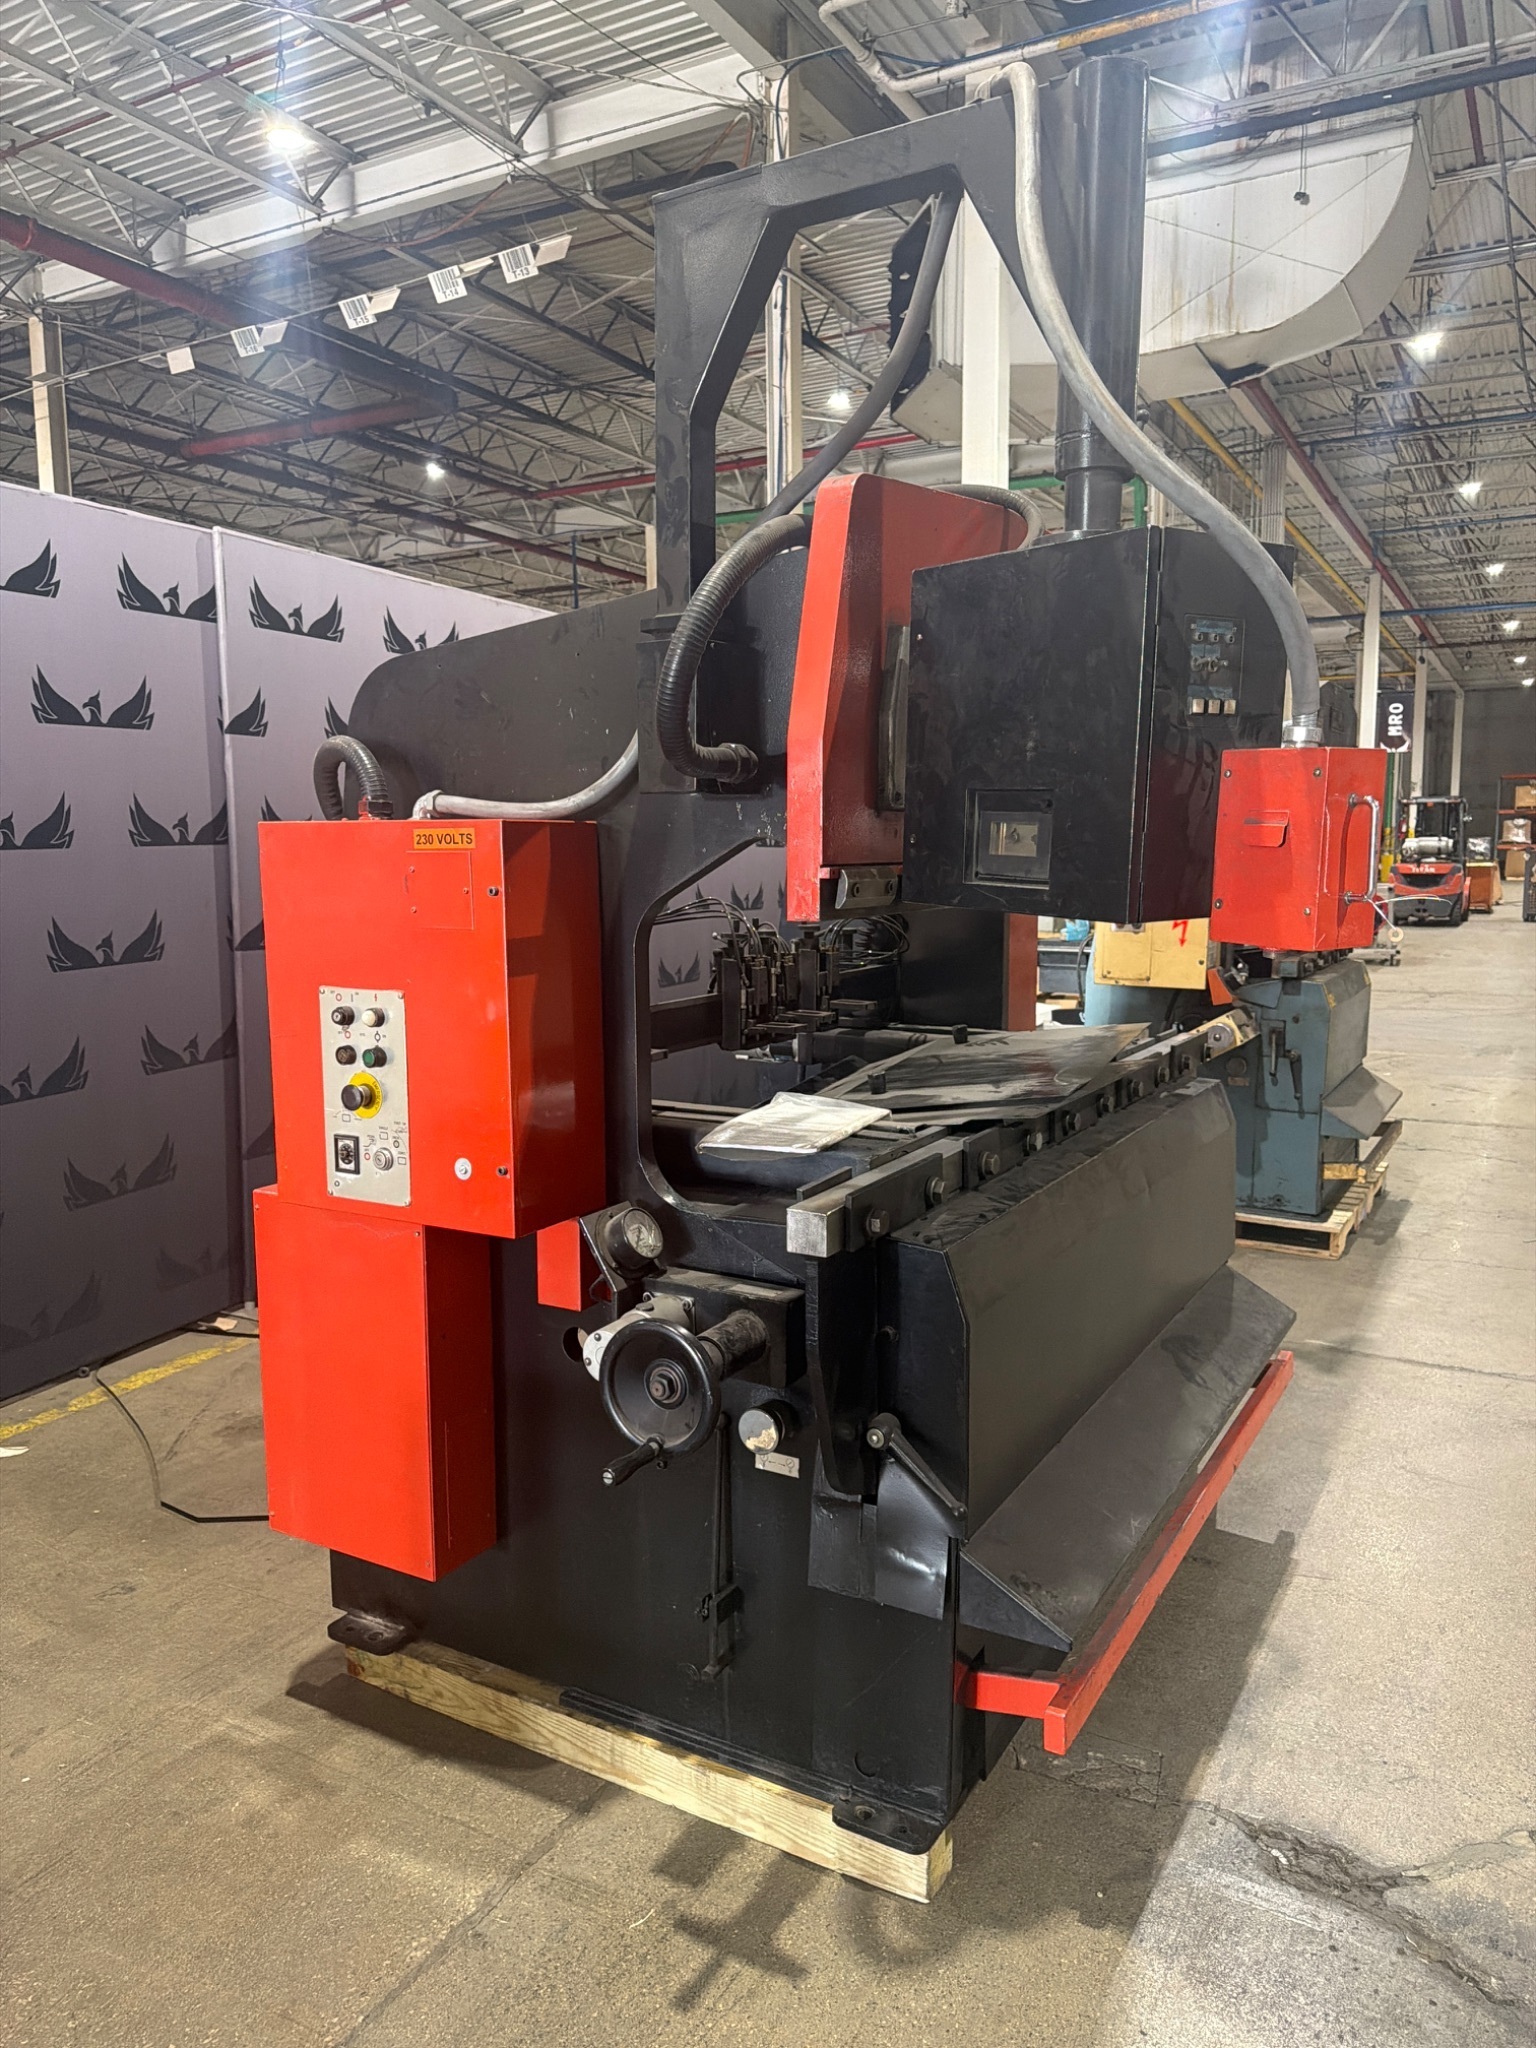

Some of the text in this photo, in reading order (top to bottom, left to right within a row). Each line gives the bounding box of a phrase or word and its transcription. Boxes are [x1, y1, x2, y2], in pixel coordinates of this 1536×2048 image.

[511, 266, 530, 280] T-13
[442, 288, 459, 300] T-14
[352, 315, 370, 326] T-15
[1387, 702, 1404, 737] MRO
[415, 833, 473, 845] 230 VOLTS
